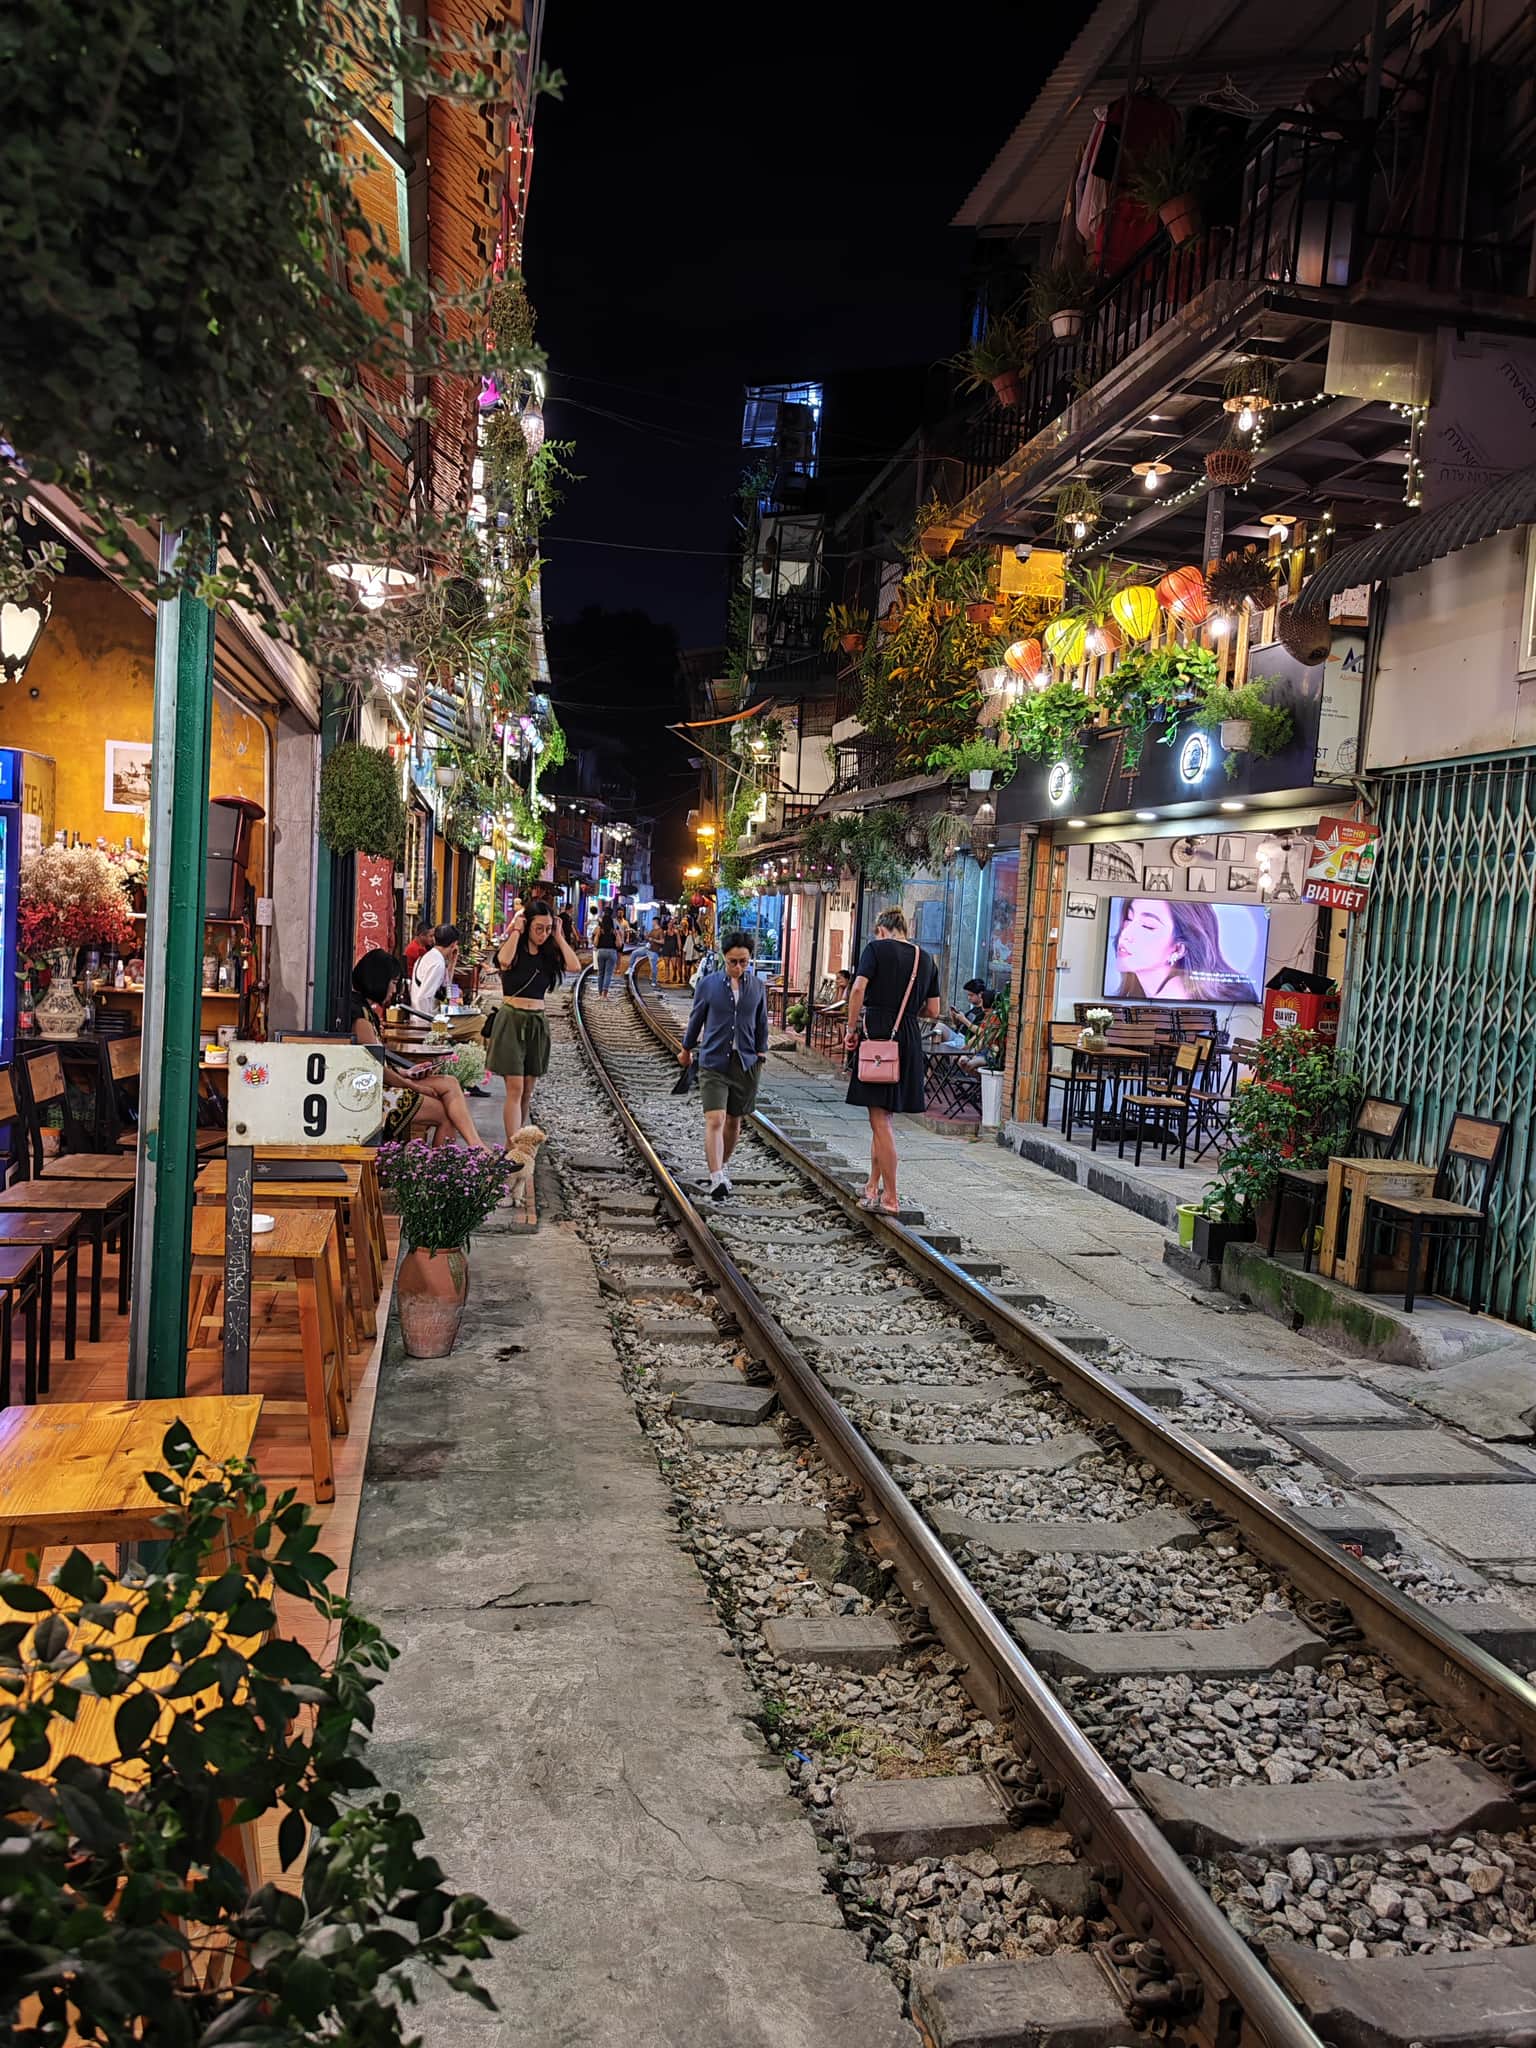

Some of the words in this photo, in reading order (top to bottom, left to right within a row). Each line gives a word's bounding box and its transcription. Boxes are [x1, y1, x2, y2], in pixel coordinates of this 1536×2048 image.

[1306, 884, 1330, 902] BIA
[1332, 888, 1365, 908] VIỆT
[303, 1094, 327, 1137] 9
